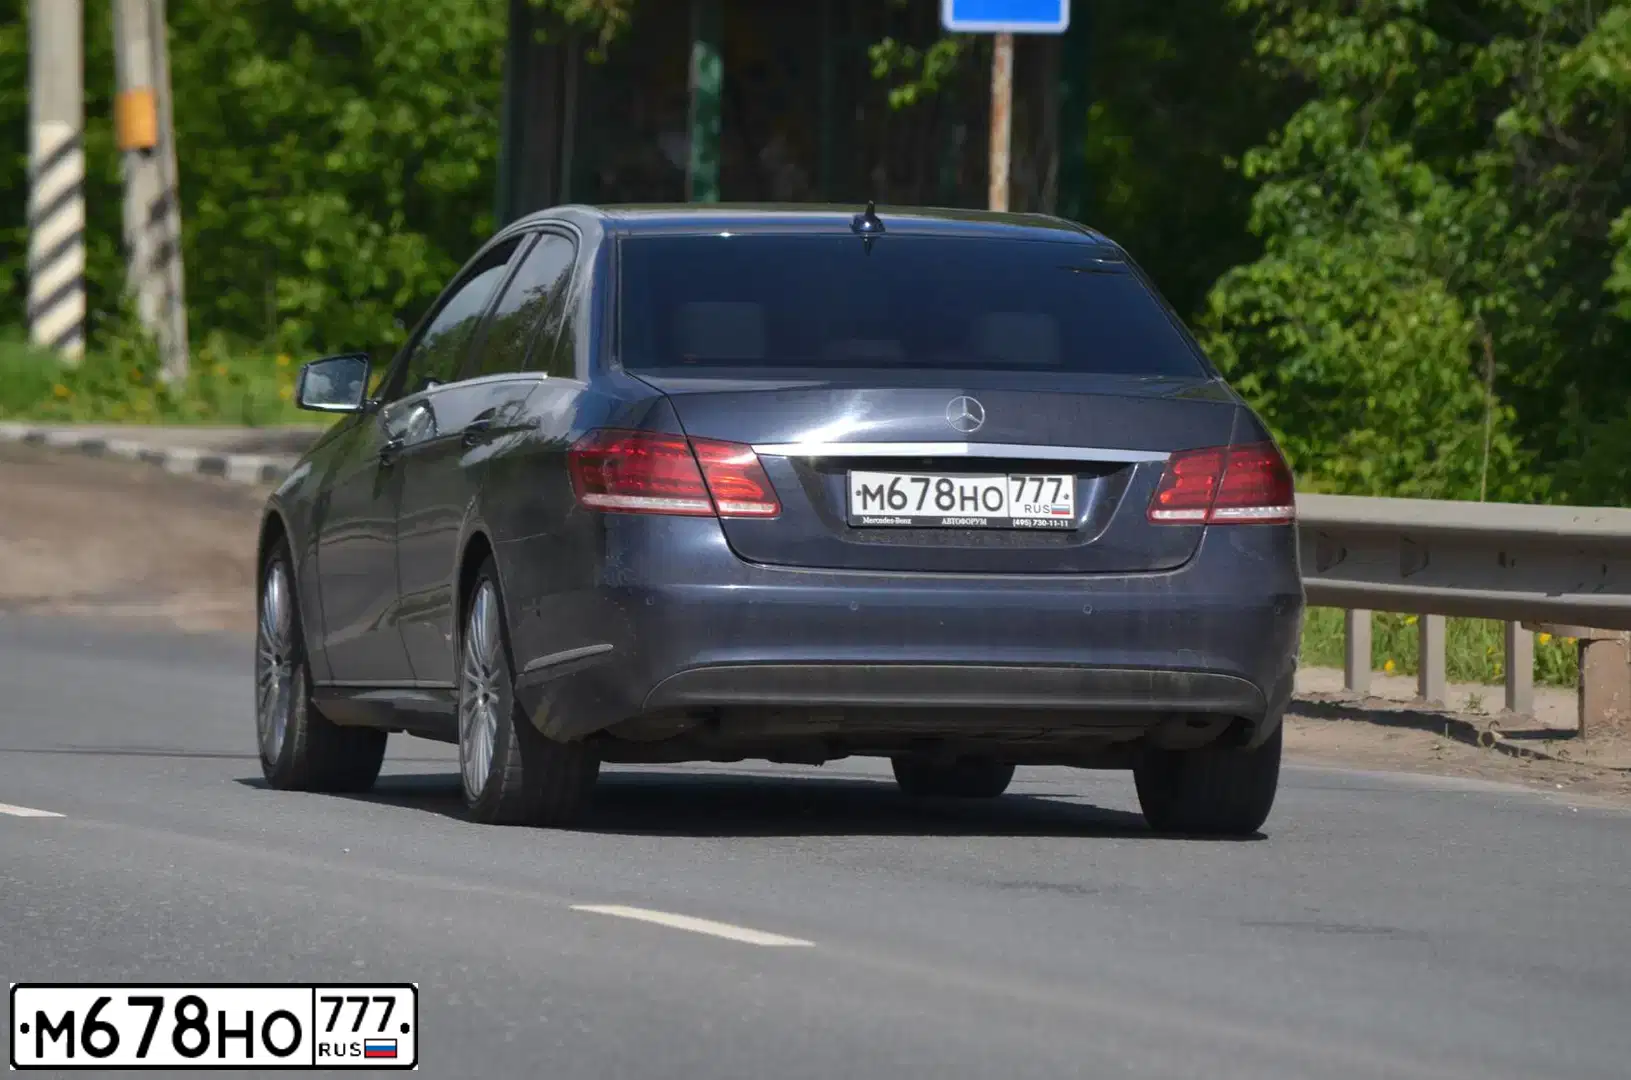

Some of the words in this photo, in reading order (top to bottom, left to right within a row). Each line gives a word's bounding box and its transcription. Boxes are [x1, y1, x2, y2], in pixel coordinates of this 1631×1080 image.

[1010, 477, 1063, 504] 777
[1024, 504, 1050, 514] RUS
[862, 517, 912, 525] Mercedes-Benz
[941, 517, 988, 526] АВТОФОРУМ
[1012, 518, 1032, 527] (495)
[1032, 518, 1069, 527] 730-11-11
